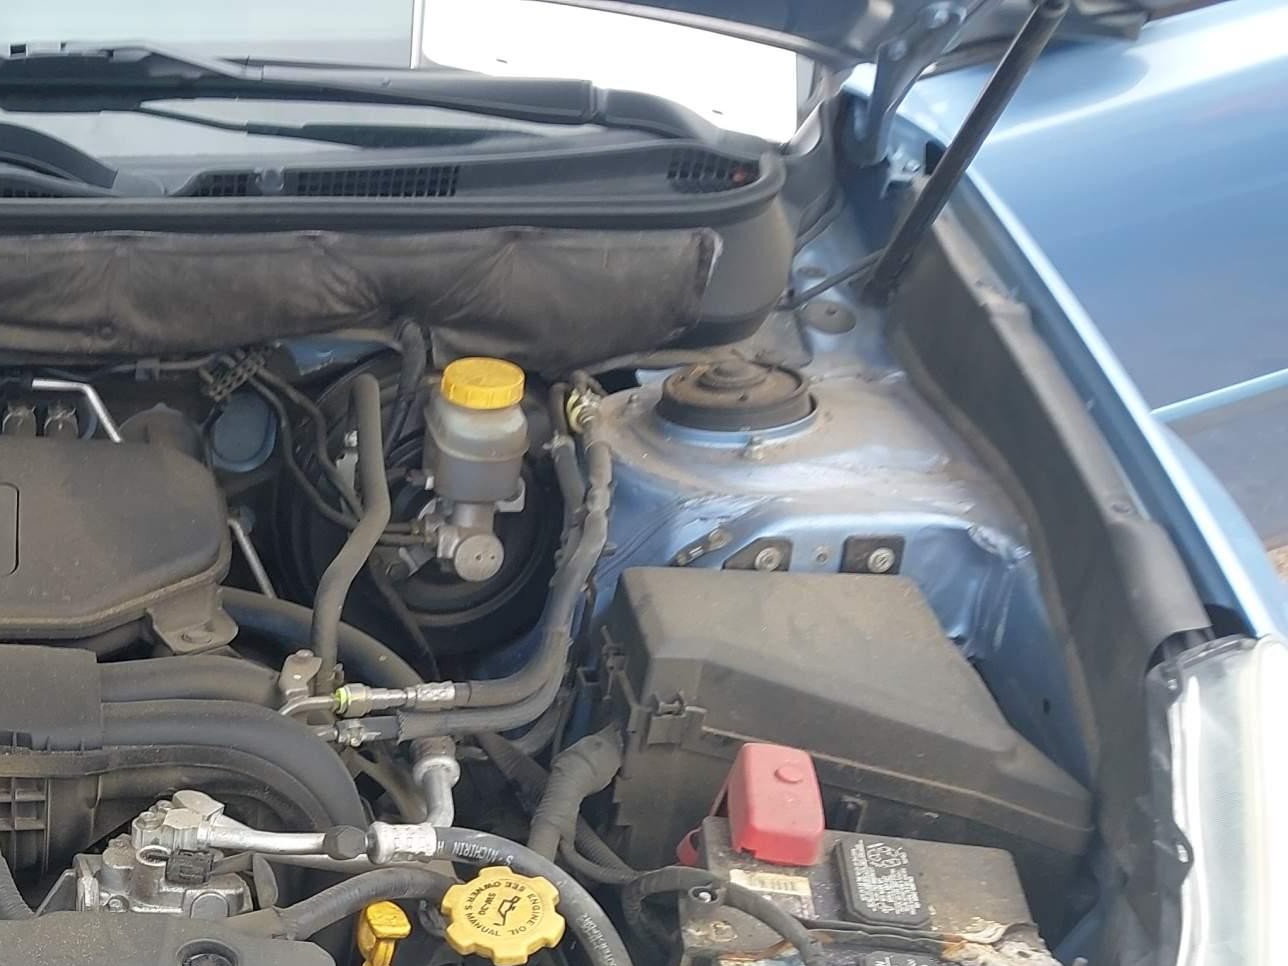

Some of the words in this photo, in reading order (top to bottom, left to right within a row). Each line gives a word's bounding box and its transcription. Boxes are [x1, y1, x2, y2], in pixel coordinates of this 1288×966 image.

[504, 881, 526, 892] SEE
[527, 893, 541, 925] ENGINE
[465, 912, 502, 937] MANUAL
[507, 926, 527, 937] OIL
